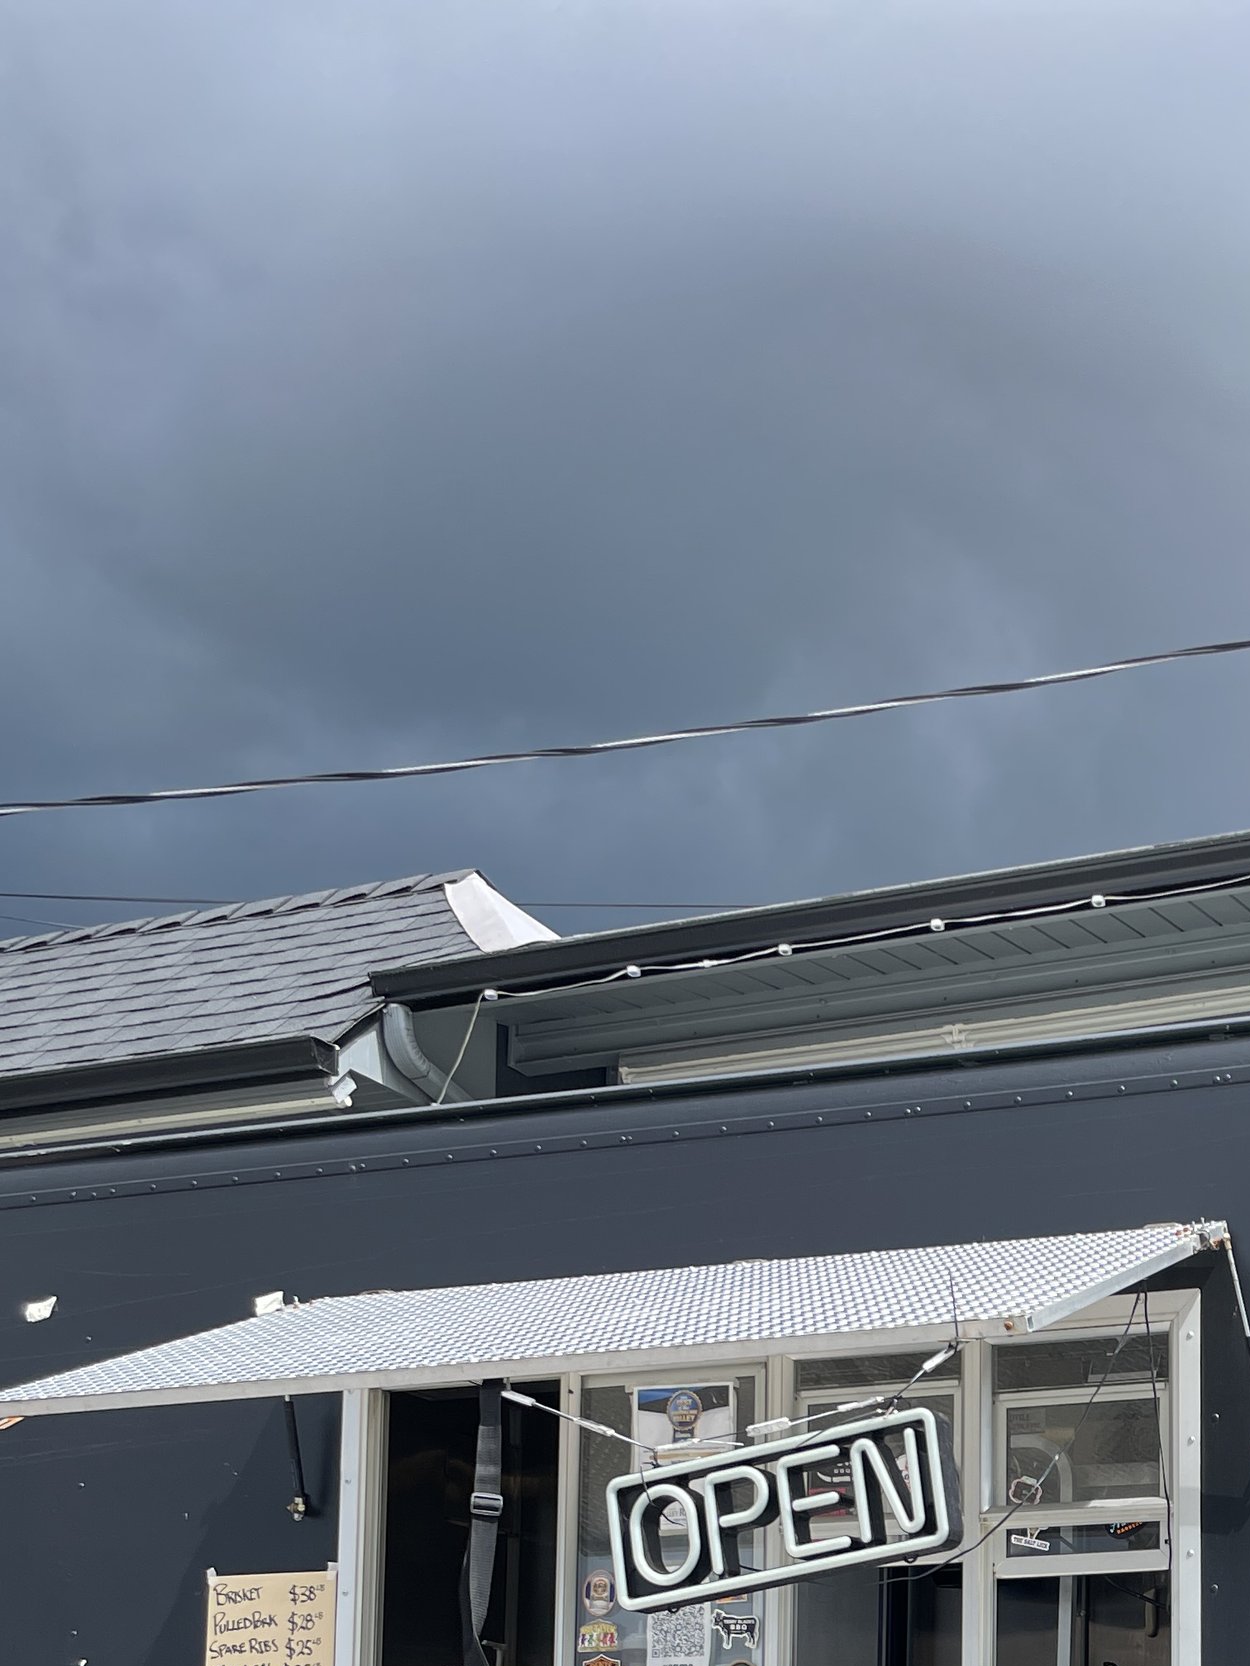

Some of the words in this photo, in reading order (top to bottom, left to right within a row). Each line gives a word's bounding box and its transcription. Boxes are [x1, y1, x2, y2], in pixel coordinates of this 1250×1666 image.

[629, 1428, 926, 1587] OPEN
[213, 1583, 263, 1606] BRISKET
[249, 1638, 279, 1655] RIBS
